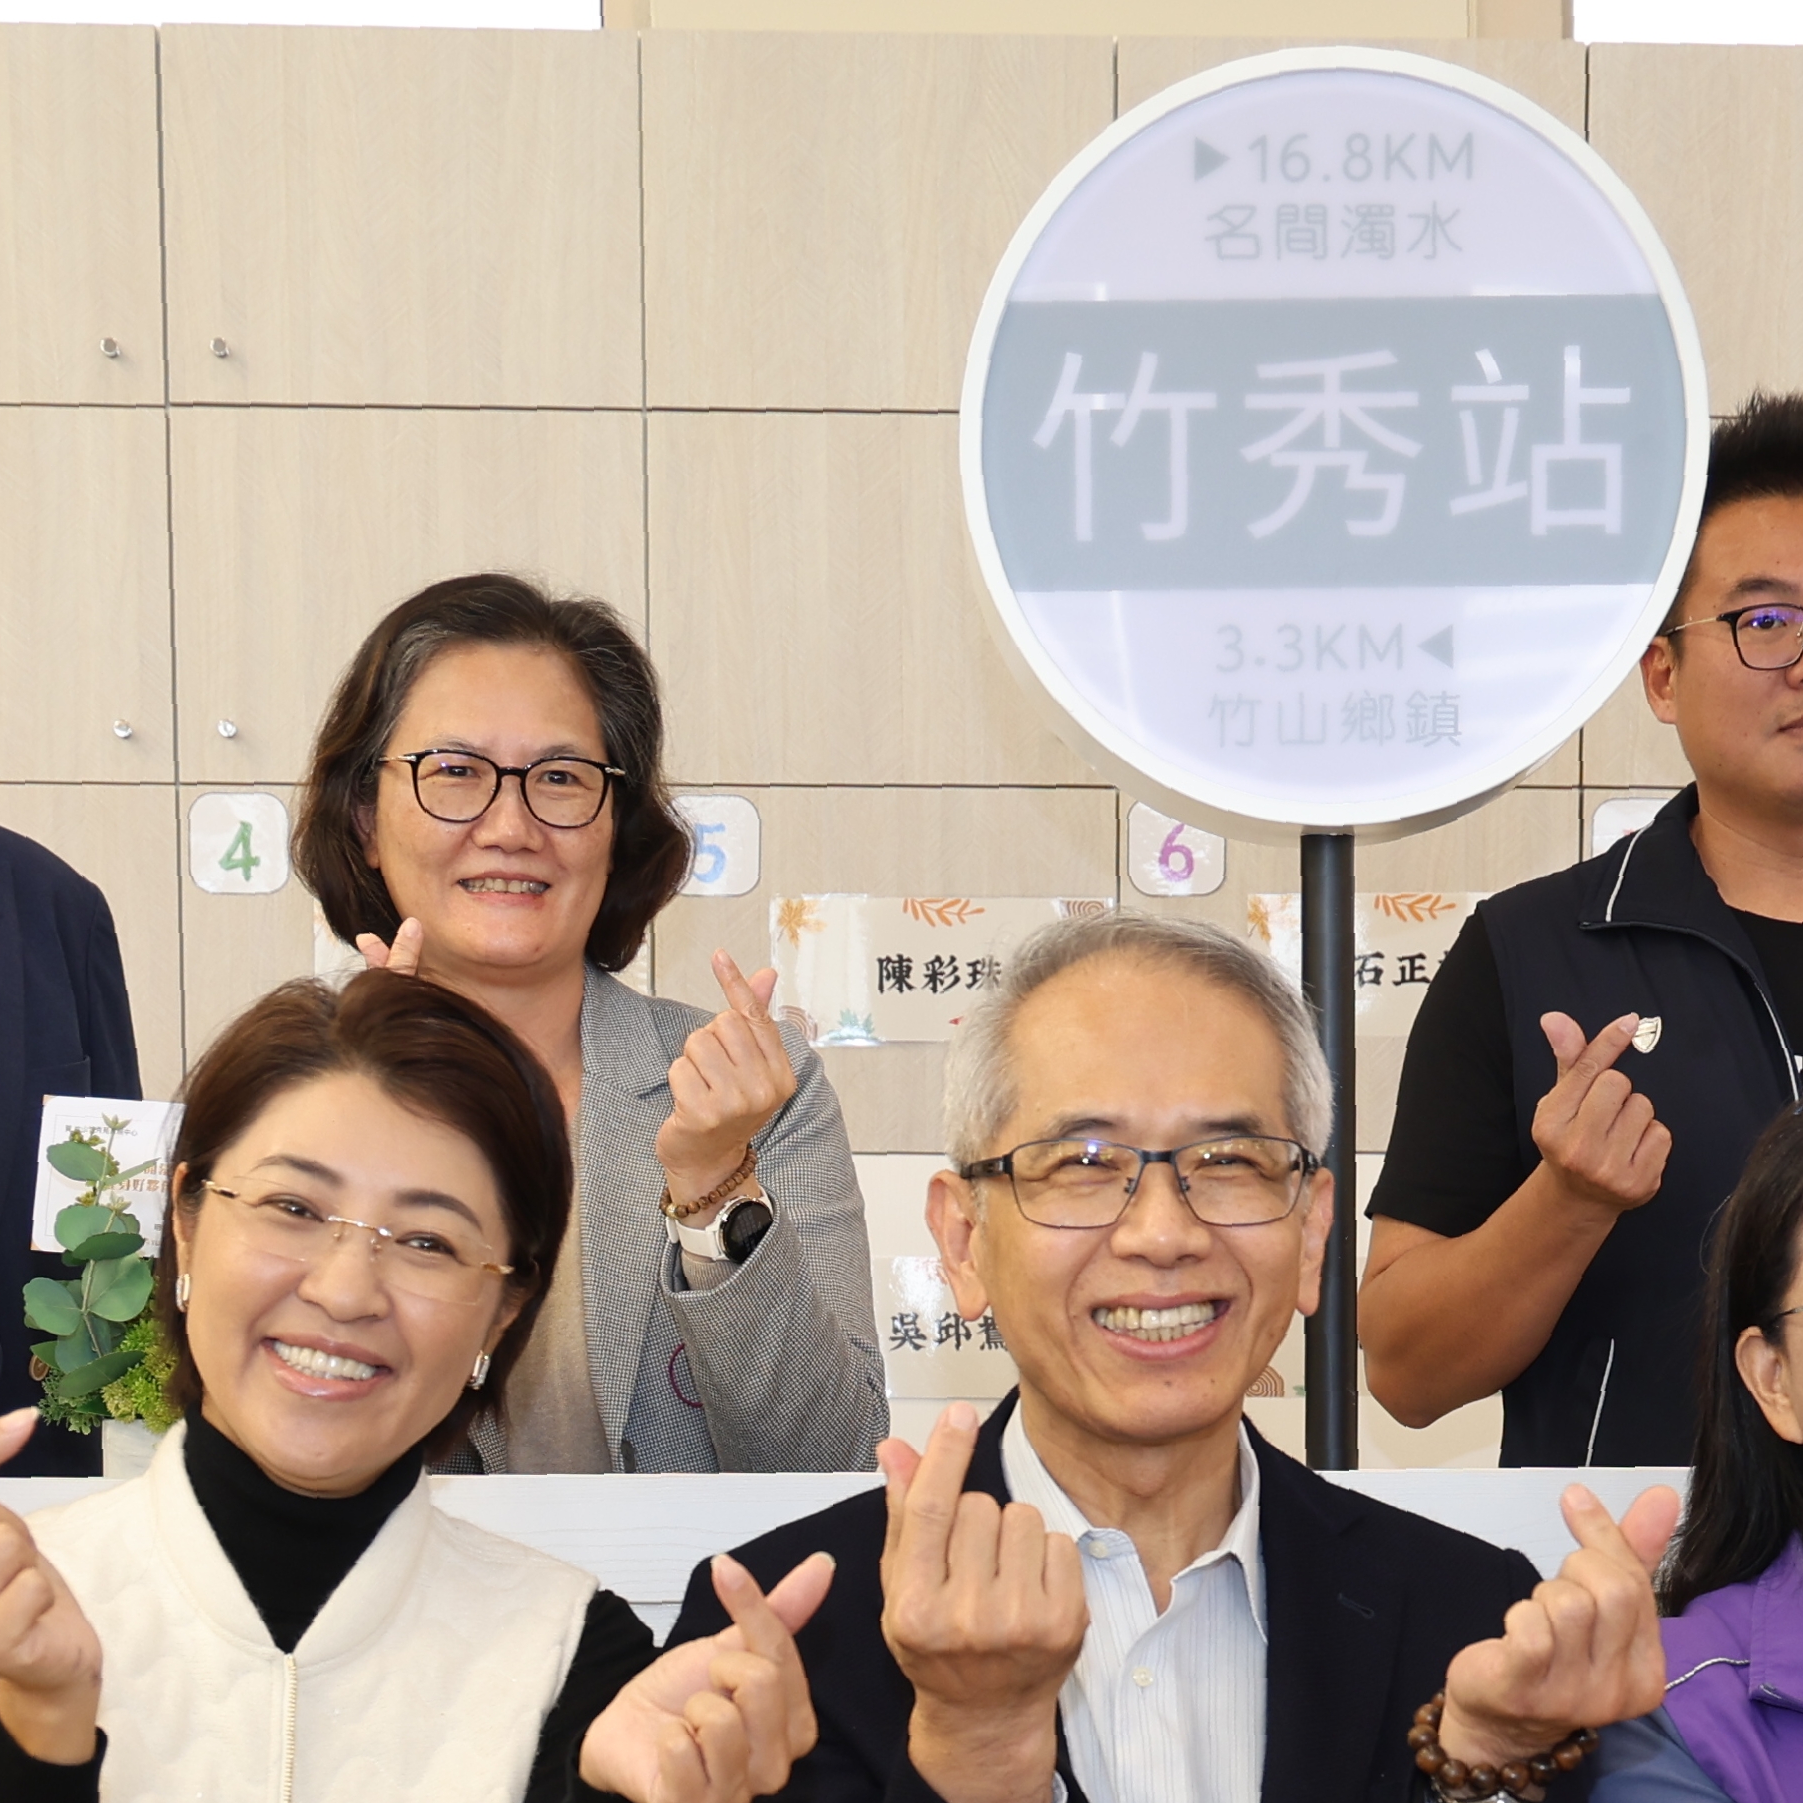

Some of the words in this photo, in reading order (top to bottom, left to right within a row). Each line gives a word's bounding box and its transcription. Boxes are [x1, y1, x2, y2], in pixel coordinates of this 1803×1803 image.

[1247, 132, 1474, 183] 16.8KM
[1205, 201, 1463, 261] 名間濁水
[1032, 345, 1631, 541] 竹秀站
[1215, 623, 1404, 673] 3.3KM
[1208, 690, 1463, 748] 竹山鄉鎮
[218, 819, 261, 882] 4
[693, 822, 727, 884] 5
[1158, 823, 1195, 883] 6
[1354, 950, 1449, 988] 石正
